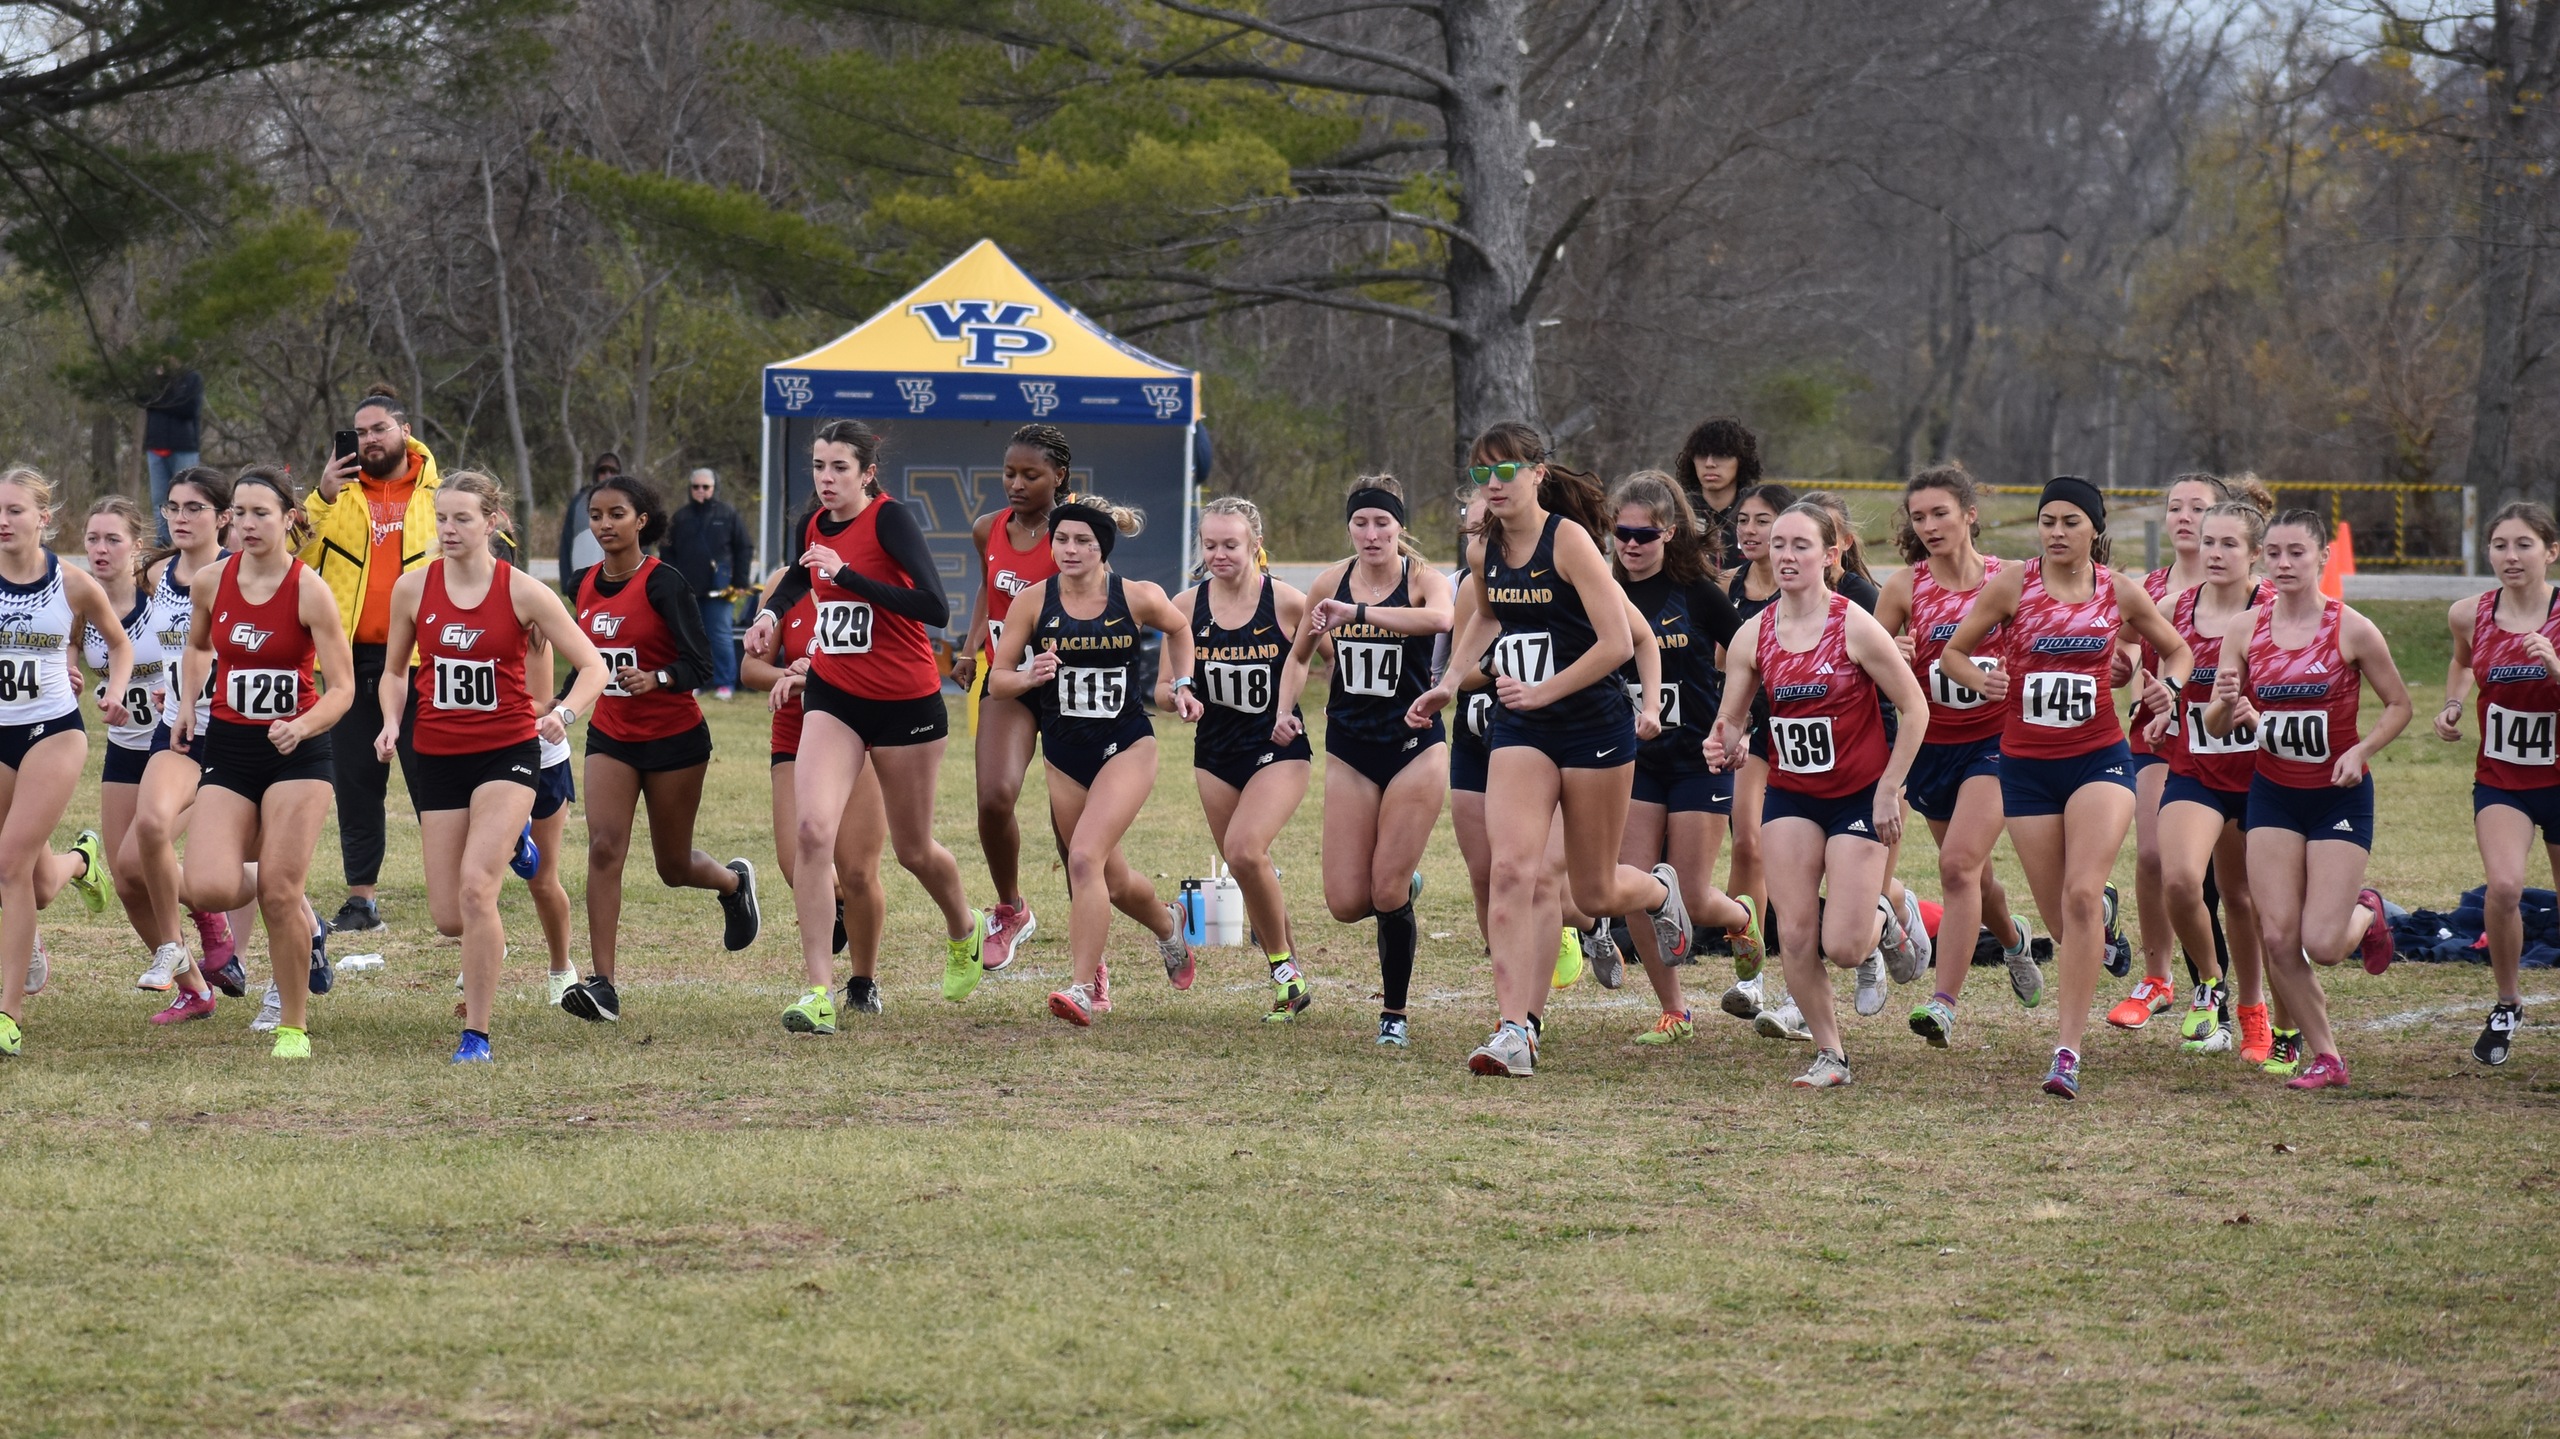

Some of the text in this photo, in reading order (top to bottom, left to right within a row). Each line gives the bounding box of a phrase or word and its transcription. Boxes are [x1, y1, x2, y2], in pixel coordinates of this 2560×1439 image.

[910, 300, 1053, 368] WP
[774, 376, 813, 409] WP
[897, 379, 936, 412] WP
[1020, 382, 1059, 415] WP
[1143, 386, 1181, 418] WP
[14, 631, 63, 649] MERCY
[229, 622, 274, 652] GV
[440, 623, 485, 651] GV
[591, 612, 626, 639] GV
[820, 605, 870, 647] 129
[1041, 635, 1133, 651] GRACELAND
[1195, 643, 1279, 661] GRACELAND
[1499, 637, 1549, 682] 117
[2032, 637, 2107, 652] PIONEERS
[436, 663, 495, 705] 130
[1341, 646, 1398, 691] 114
[232, 673, 294, 713] 128
[1063, 670, 1123, 712] 115
[1209, 667, 1268, 708] 118
[1774, 684, 1828, 700] PIONEERS
[2029, 677, 2092, 721] 145
[2257, 684, 2329, 698] PIONEERS
[1774, 722, 1831, 767] 139
[2264, 715, 2326, 757] 140
[2491, 711, 2552, 758] 144
